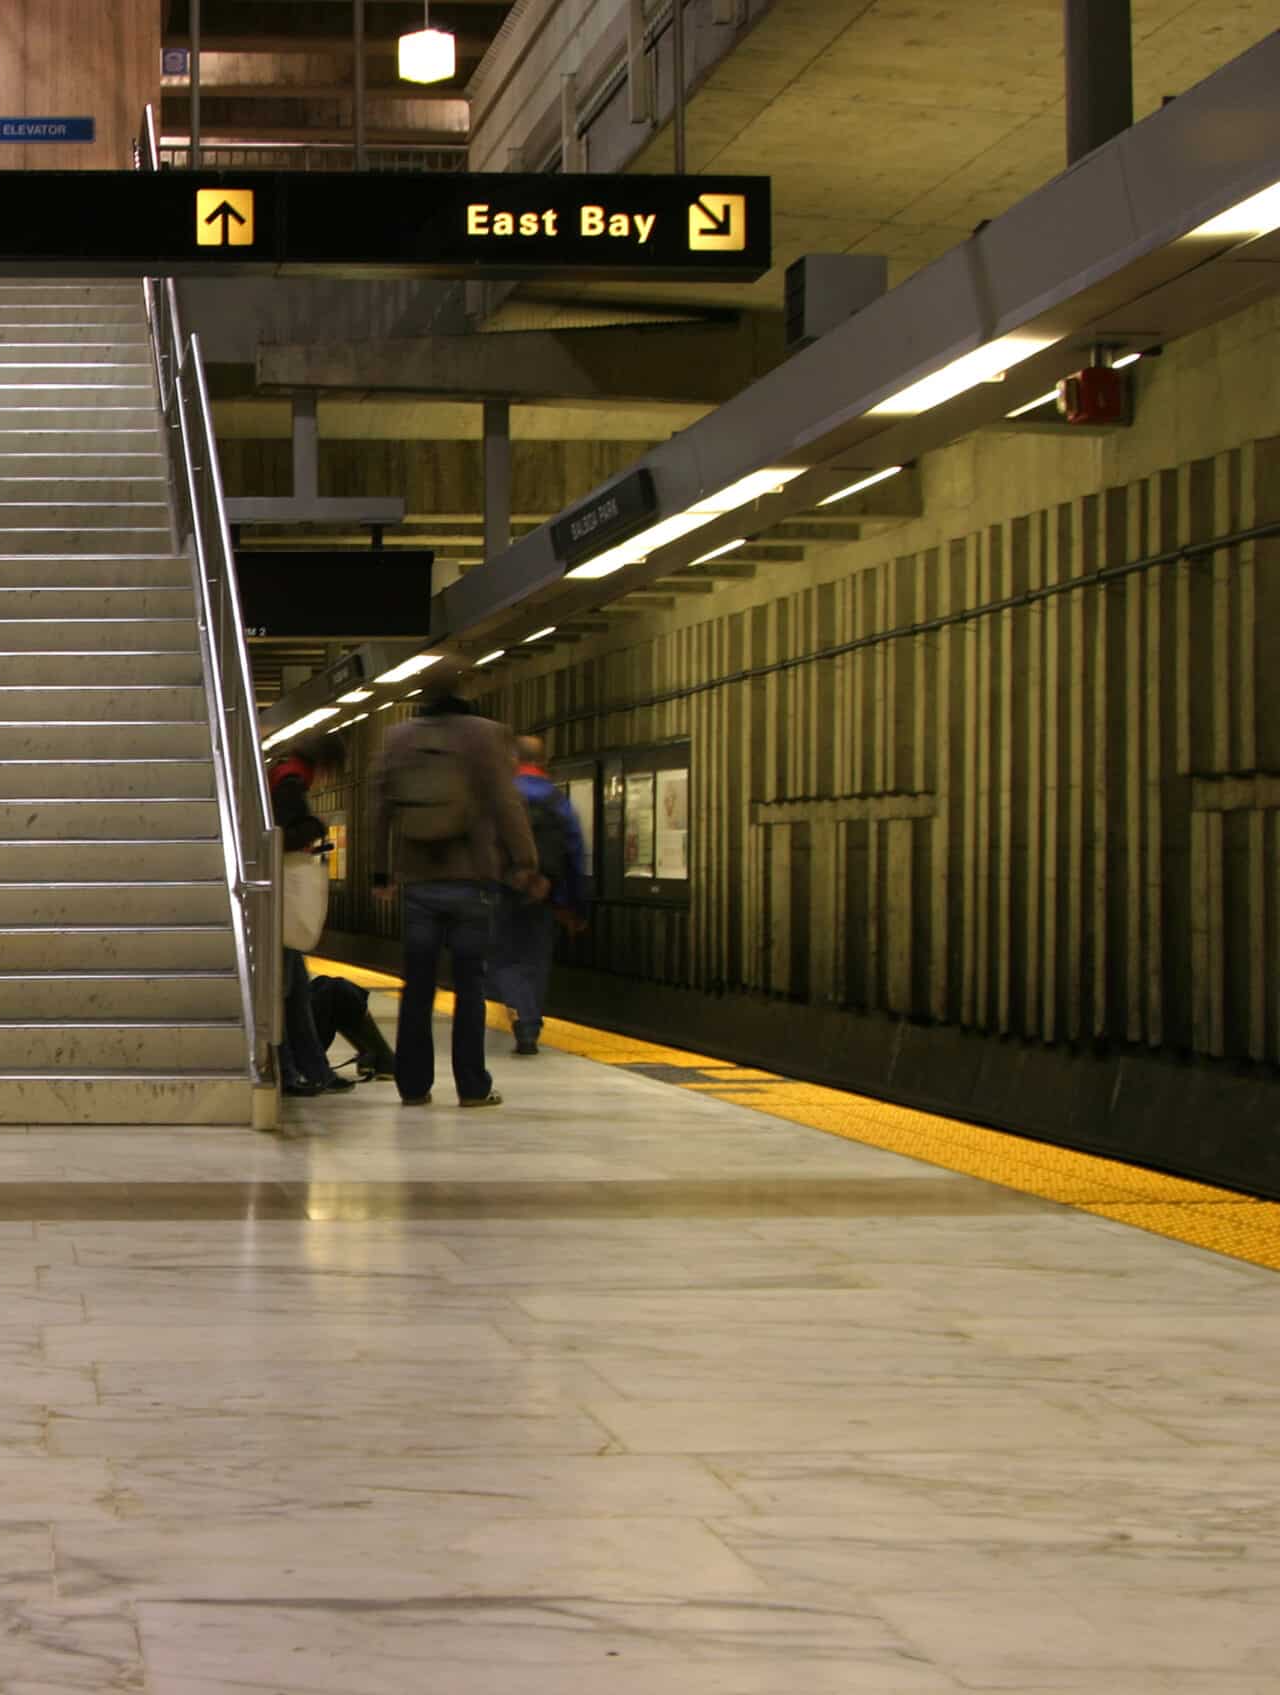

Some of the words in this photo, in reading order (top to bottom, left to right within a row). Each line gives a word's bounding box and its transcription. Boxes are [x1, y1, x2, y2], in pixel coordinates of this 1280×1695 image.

[2, 123, 67, 136] ELEVATOR
[467, 204, 559, 237] East
[580, 204, 656, 244] Bay
[597, 498, 618, 522] PARK
